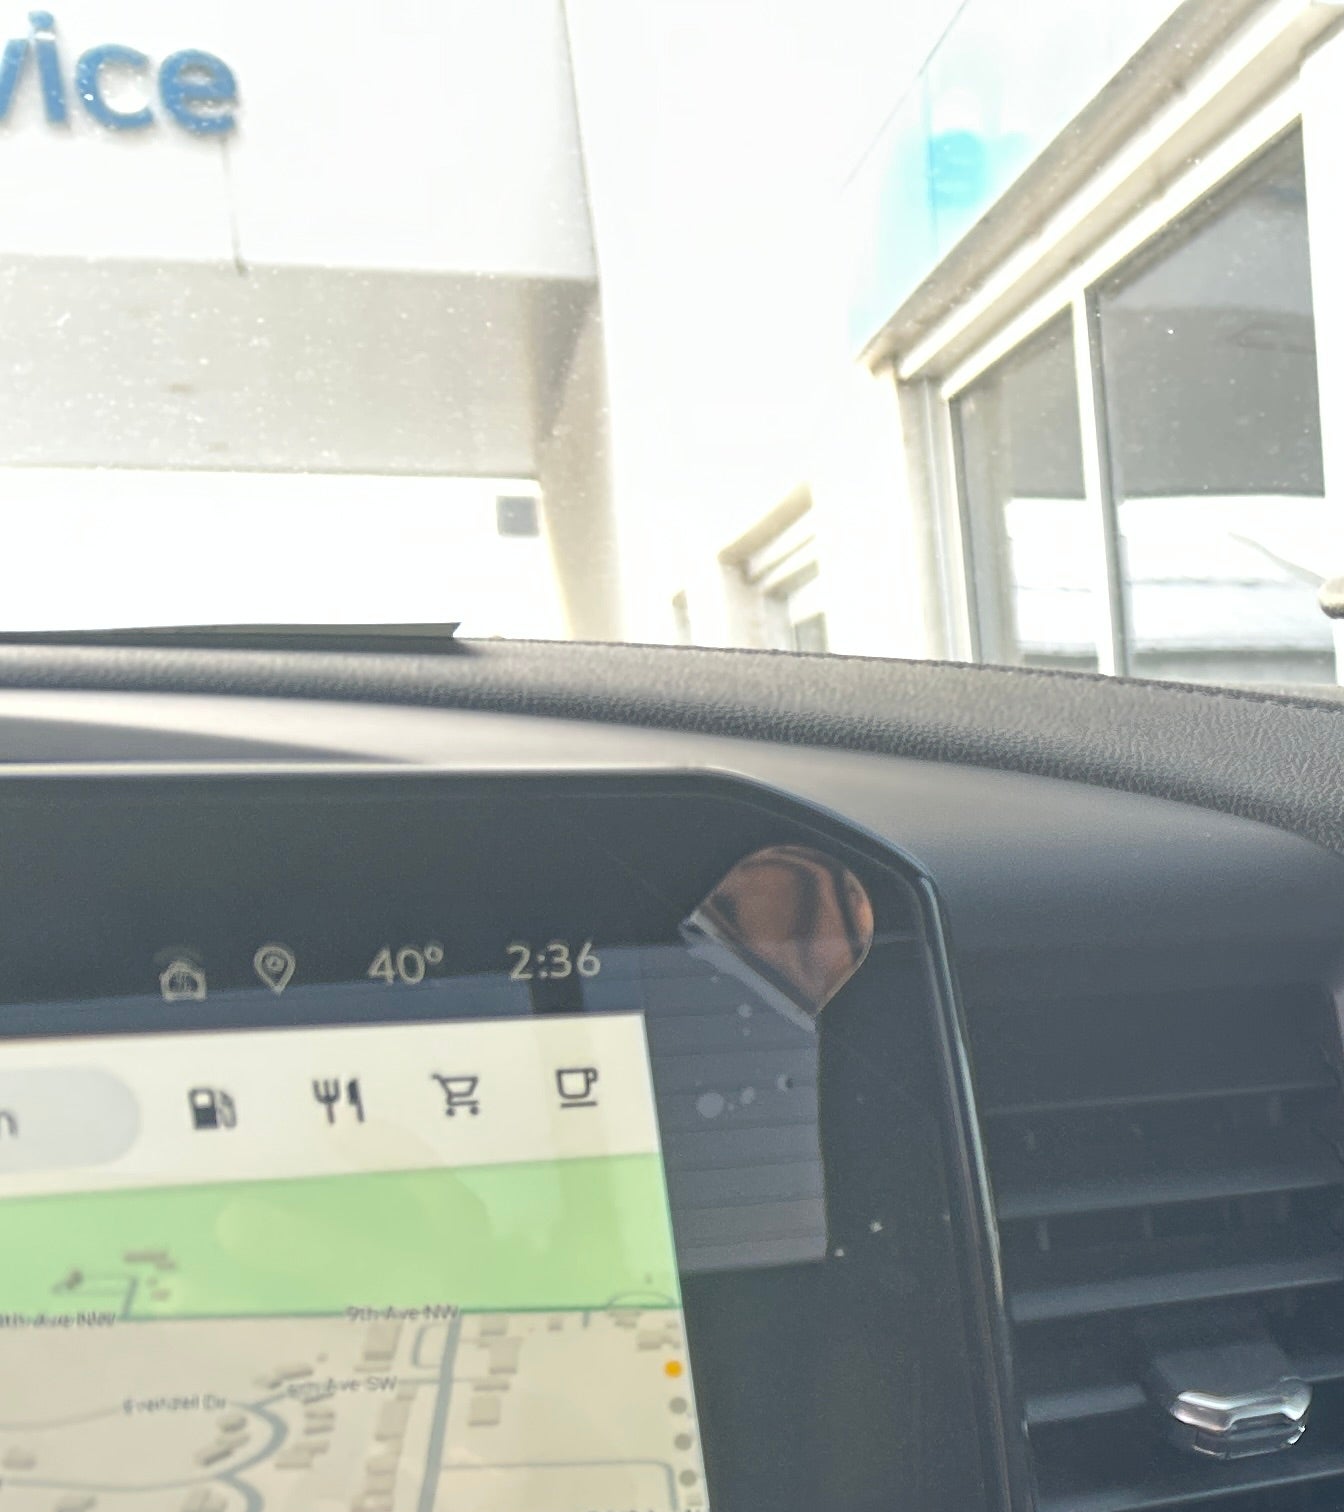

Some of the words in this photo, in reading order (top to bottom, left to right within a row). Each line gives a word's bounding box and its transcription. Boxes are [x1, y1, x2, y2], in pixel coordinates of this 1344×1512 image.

[507, 941, 601, 981] 2:36
[385, 1305, 420, 1321] Ave
[423, 1304, 458, 1320] NW
[367, 1375, 397, 1391] SW
